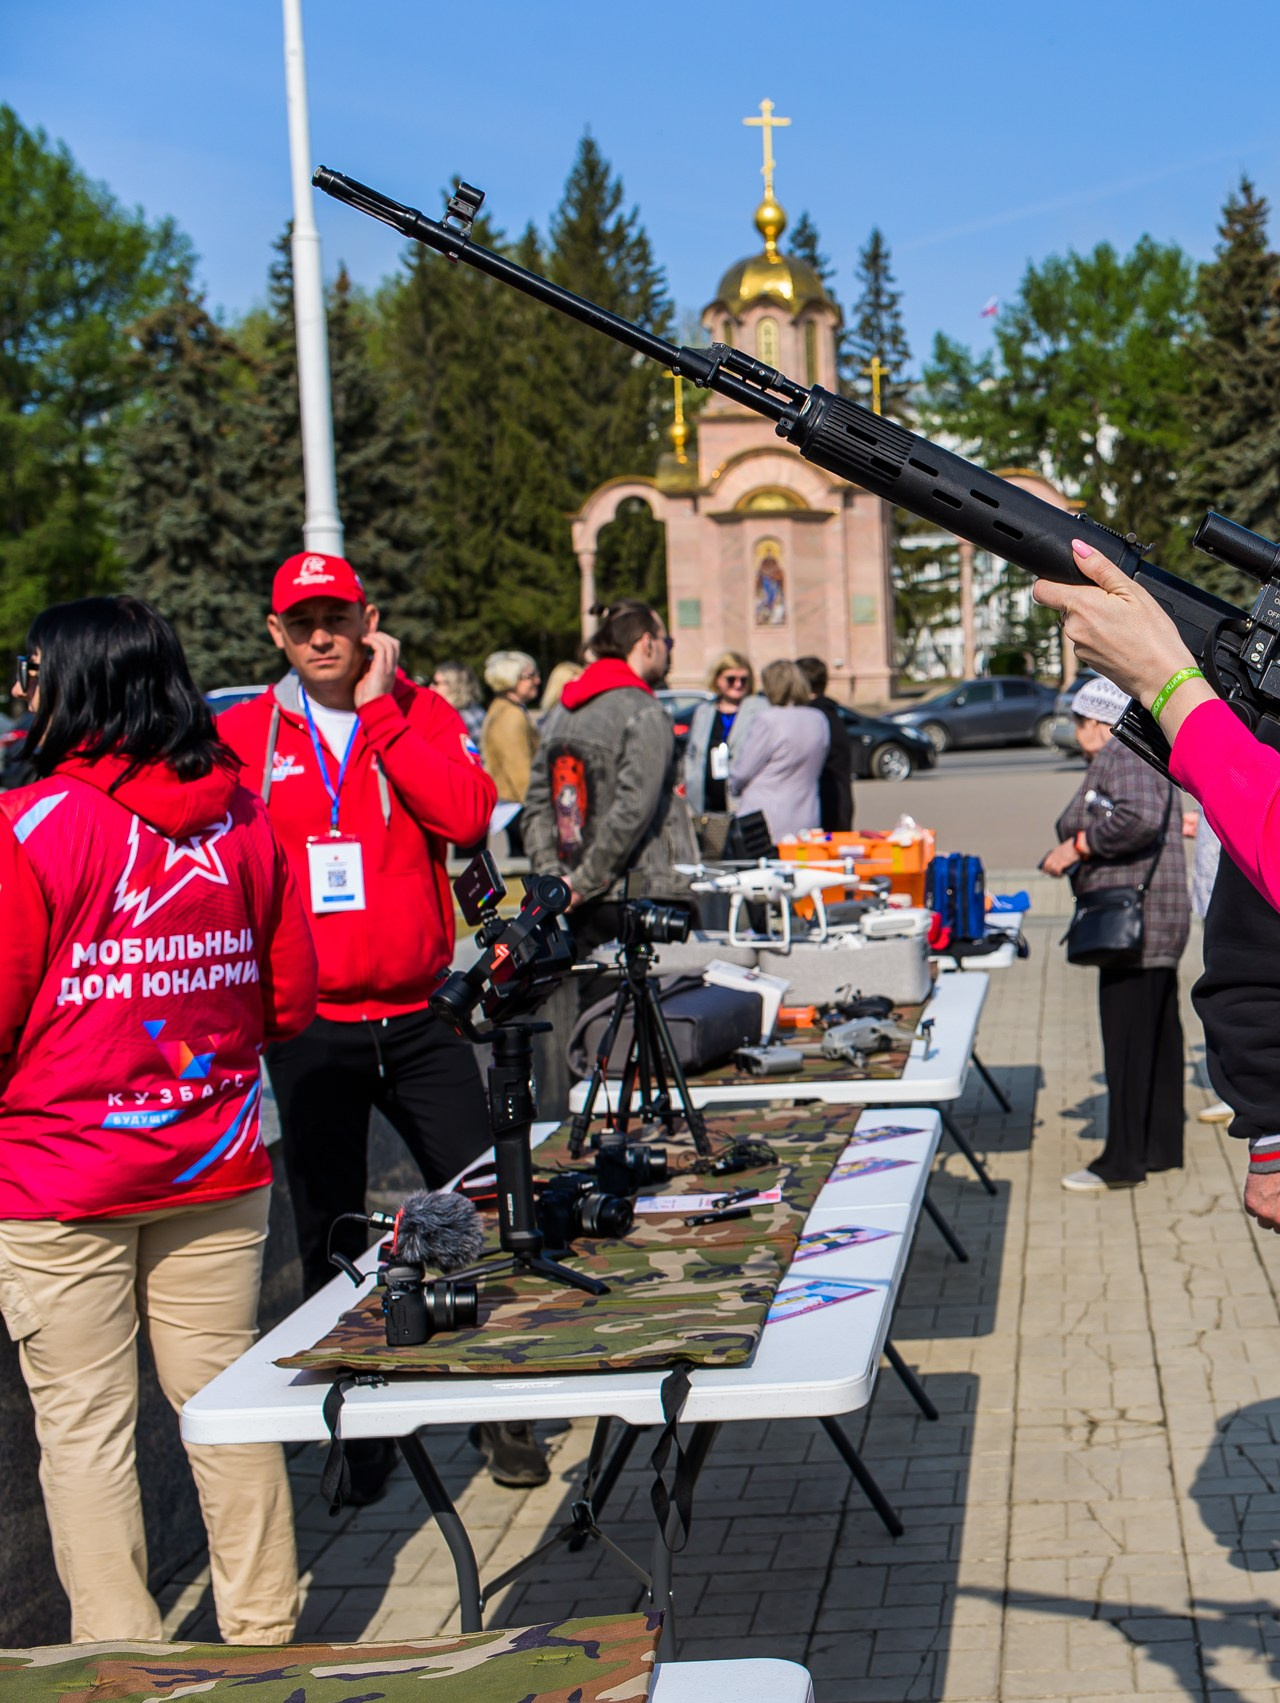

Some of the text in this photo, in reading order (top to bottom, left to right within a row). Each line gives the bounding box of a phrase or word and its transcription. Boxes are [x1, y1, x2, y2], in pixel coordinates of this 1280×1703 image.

[1267, 609, 1280, 619] OFF
[1164, 672, 1184, 694] ЖИТЬ!
[56, 972, 132, 1006] ДОМ
